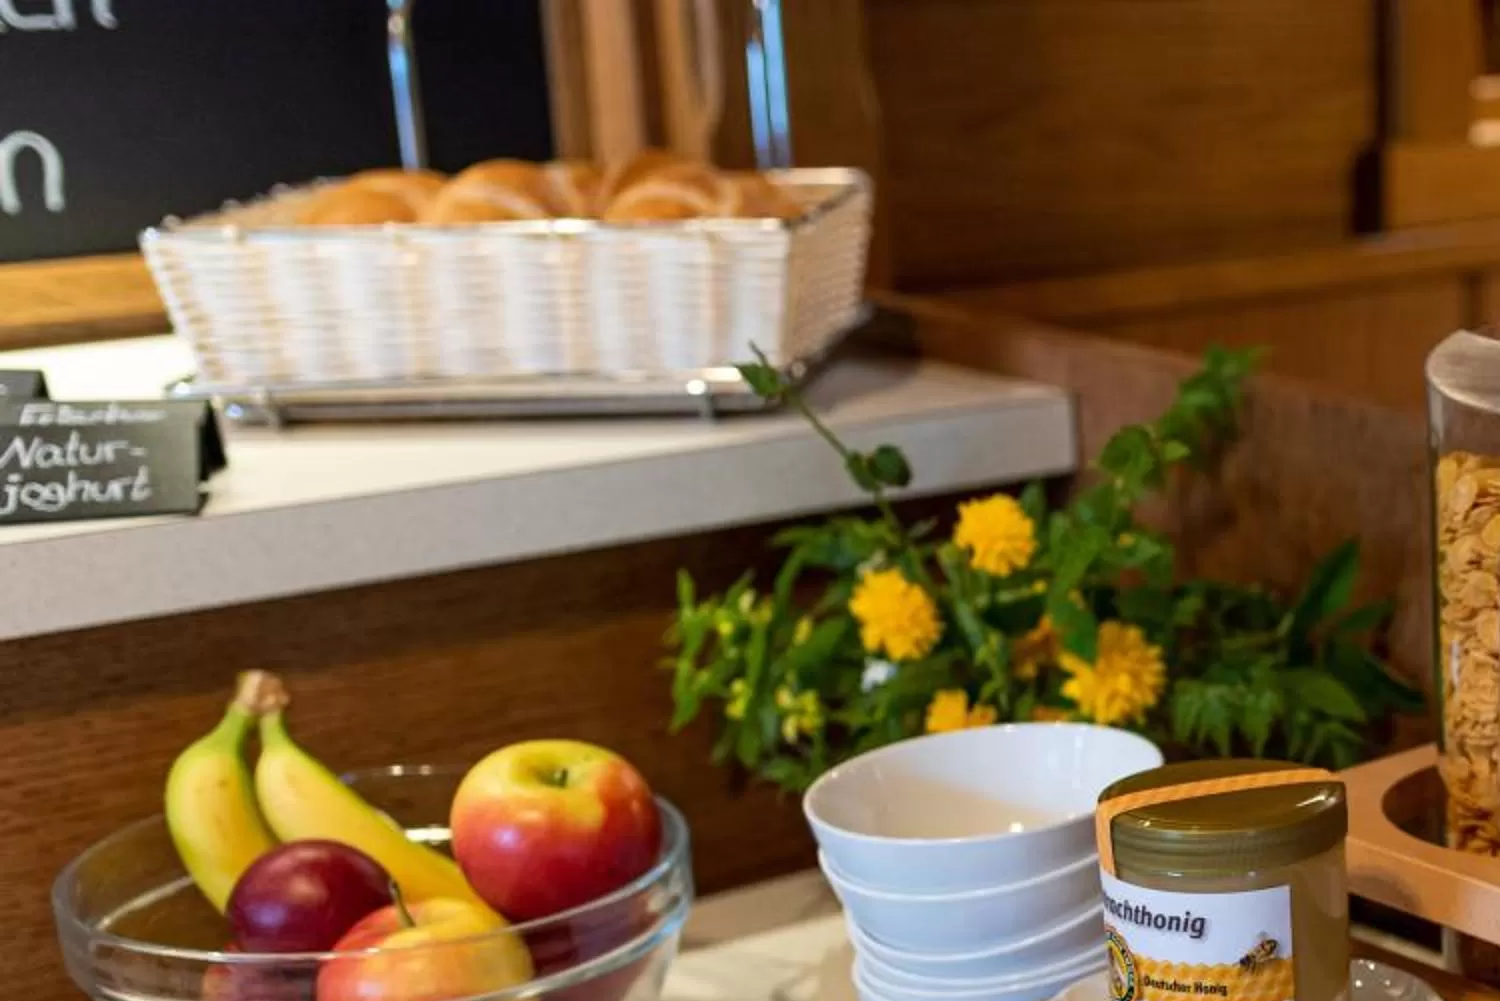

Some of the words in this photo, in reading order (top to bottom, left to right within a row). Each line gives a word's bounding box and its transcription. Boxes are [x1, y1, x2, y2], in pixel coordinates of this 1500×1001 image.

[0, 430, 146, 469] Natur-
[1144, 975, 1192, 993] Deutscher
[1194, 981, 1228, 997] Honig
